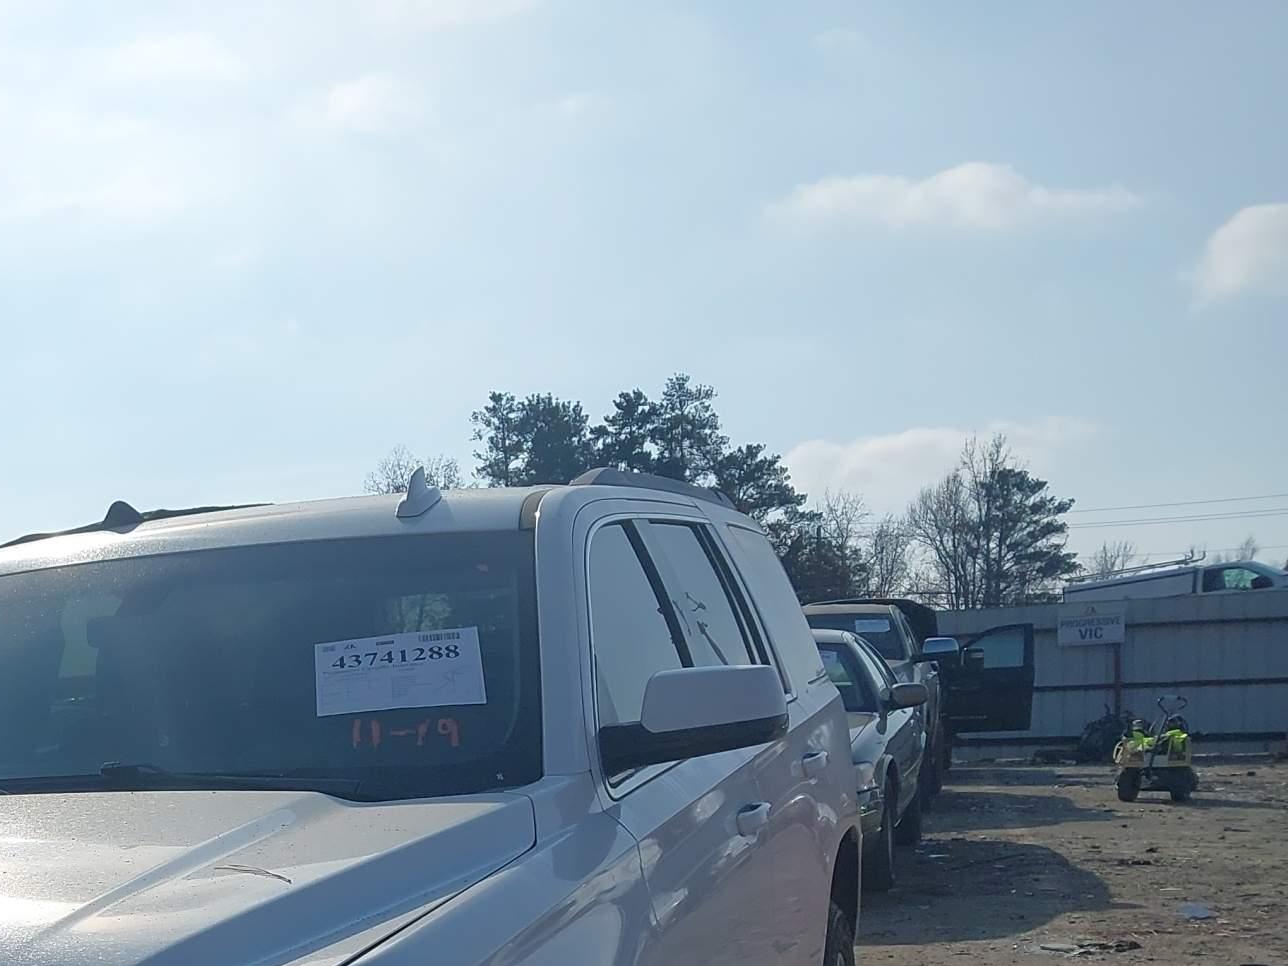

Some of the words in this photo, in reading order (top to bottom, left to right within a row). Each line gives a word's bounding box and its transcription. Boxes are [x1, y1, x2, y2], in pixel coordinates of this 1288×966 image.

[1078, 627, 1103, 640] VIC
[332, 645, 461, 669] 43741288
[352, 718, 460, 749] 11-19
